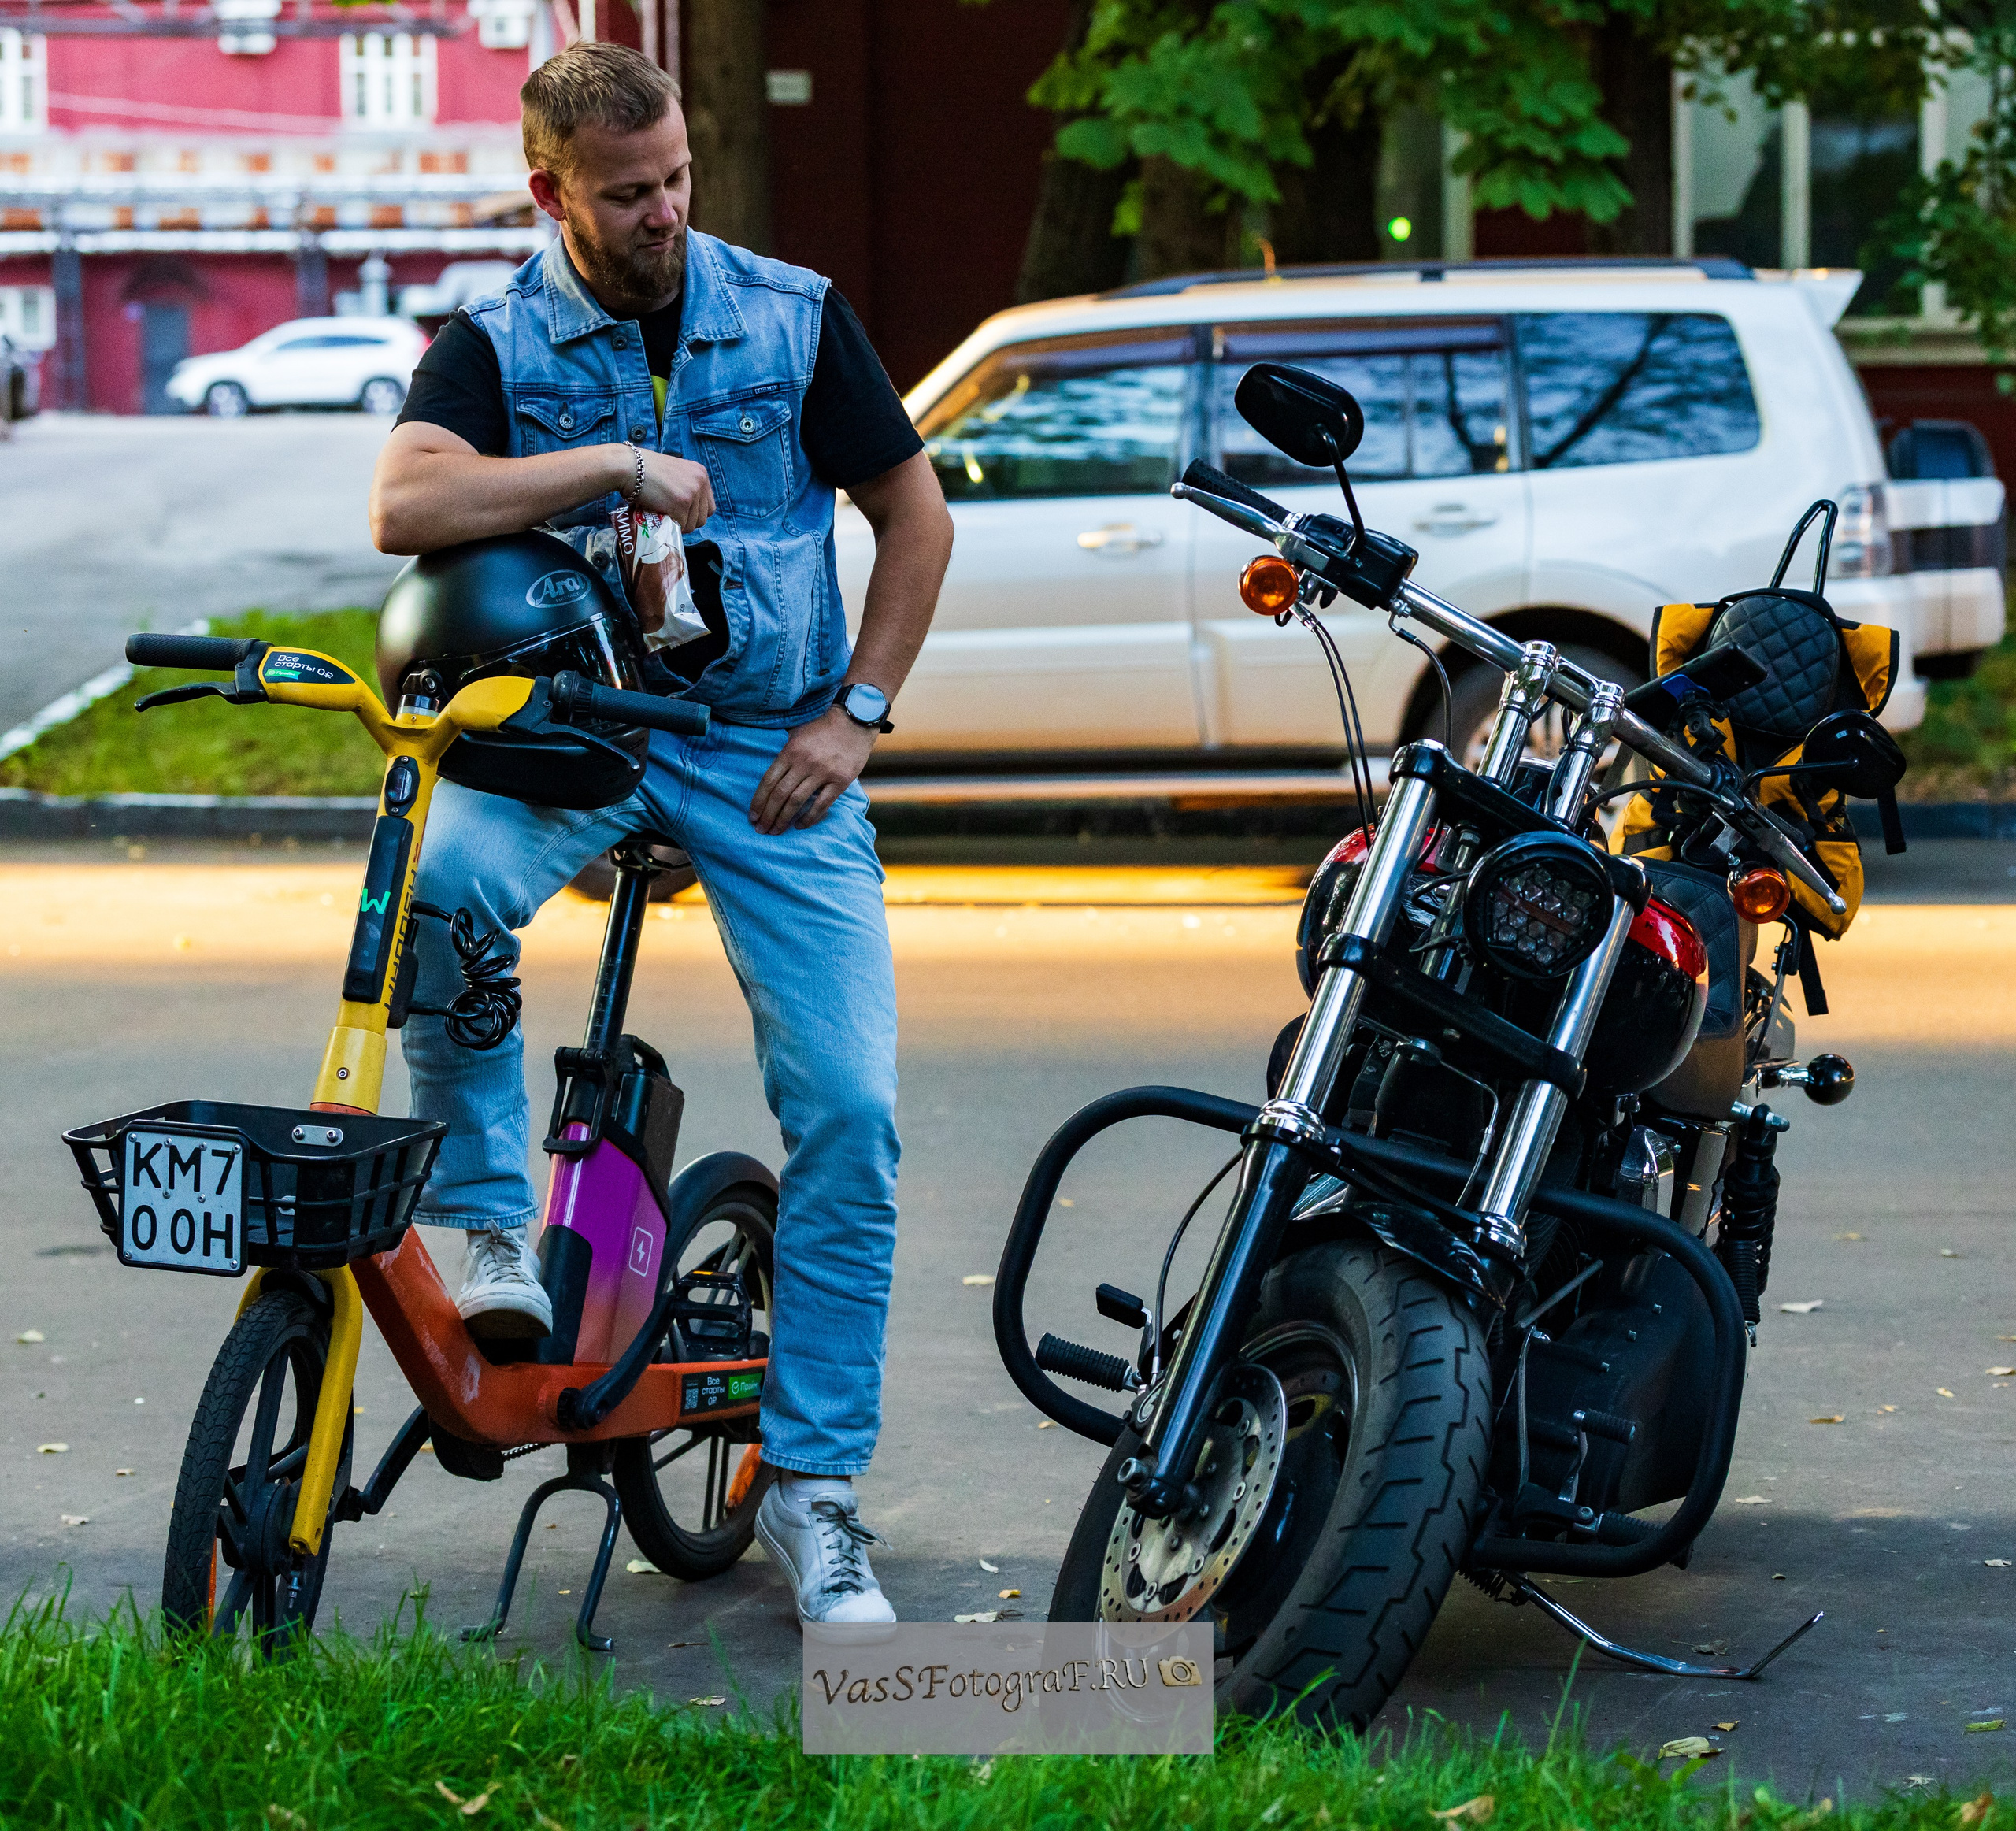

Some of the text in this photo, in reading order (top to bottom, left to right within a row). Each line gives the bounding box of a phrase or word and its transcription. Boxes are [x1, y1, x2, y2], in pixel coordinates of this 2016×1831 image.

[536, 573, 585, 605] Arai
[274, 662, 316, 673] старты
[707, 1377, 720, 1386] Все
[702, 1387, 725, 1395] старты
